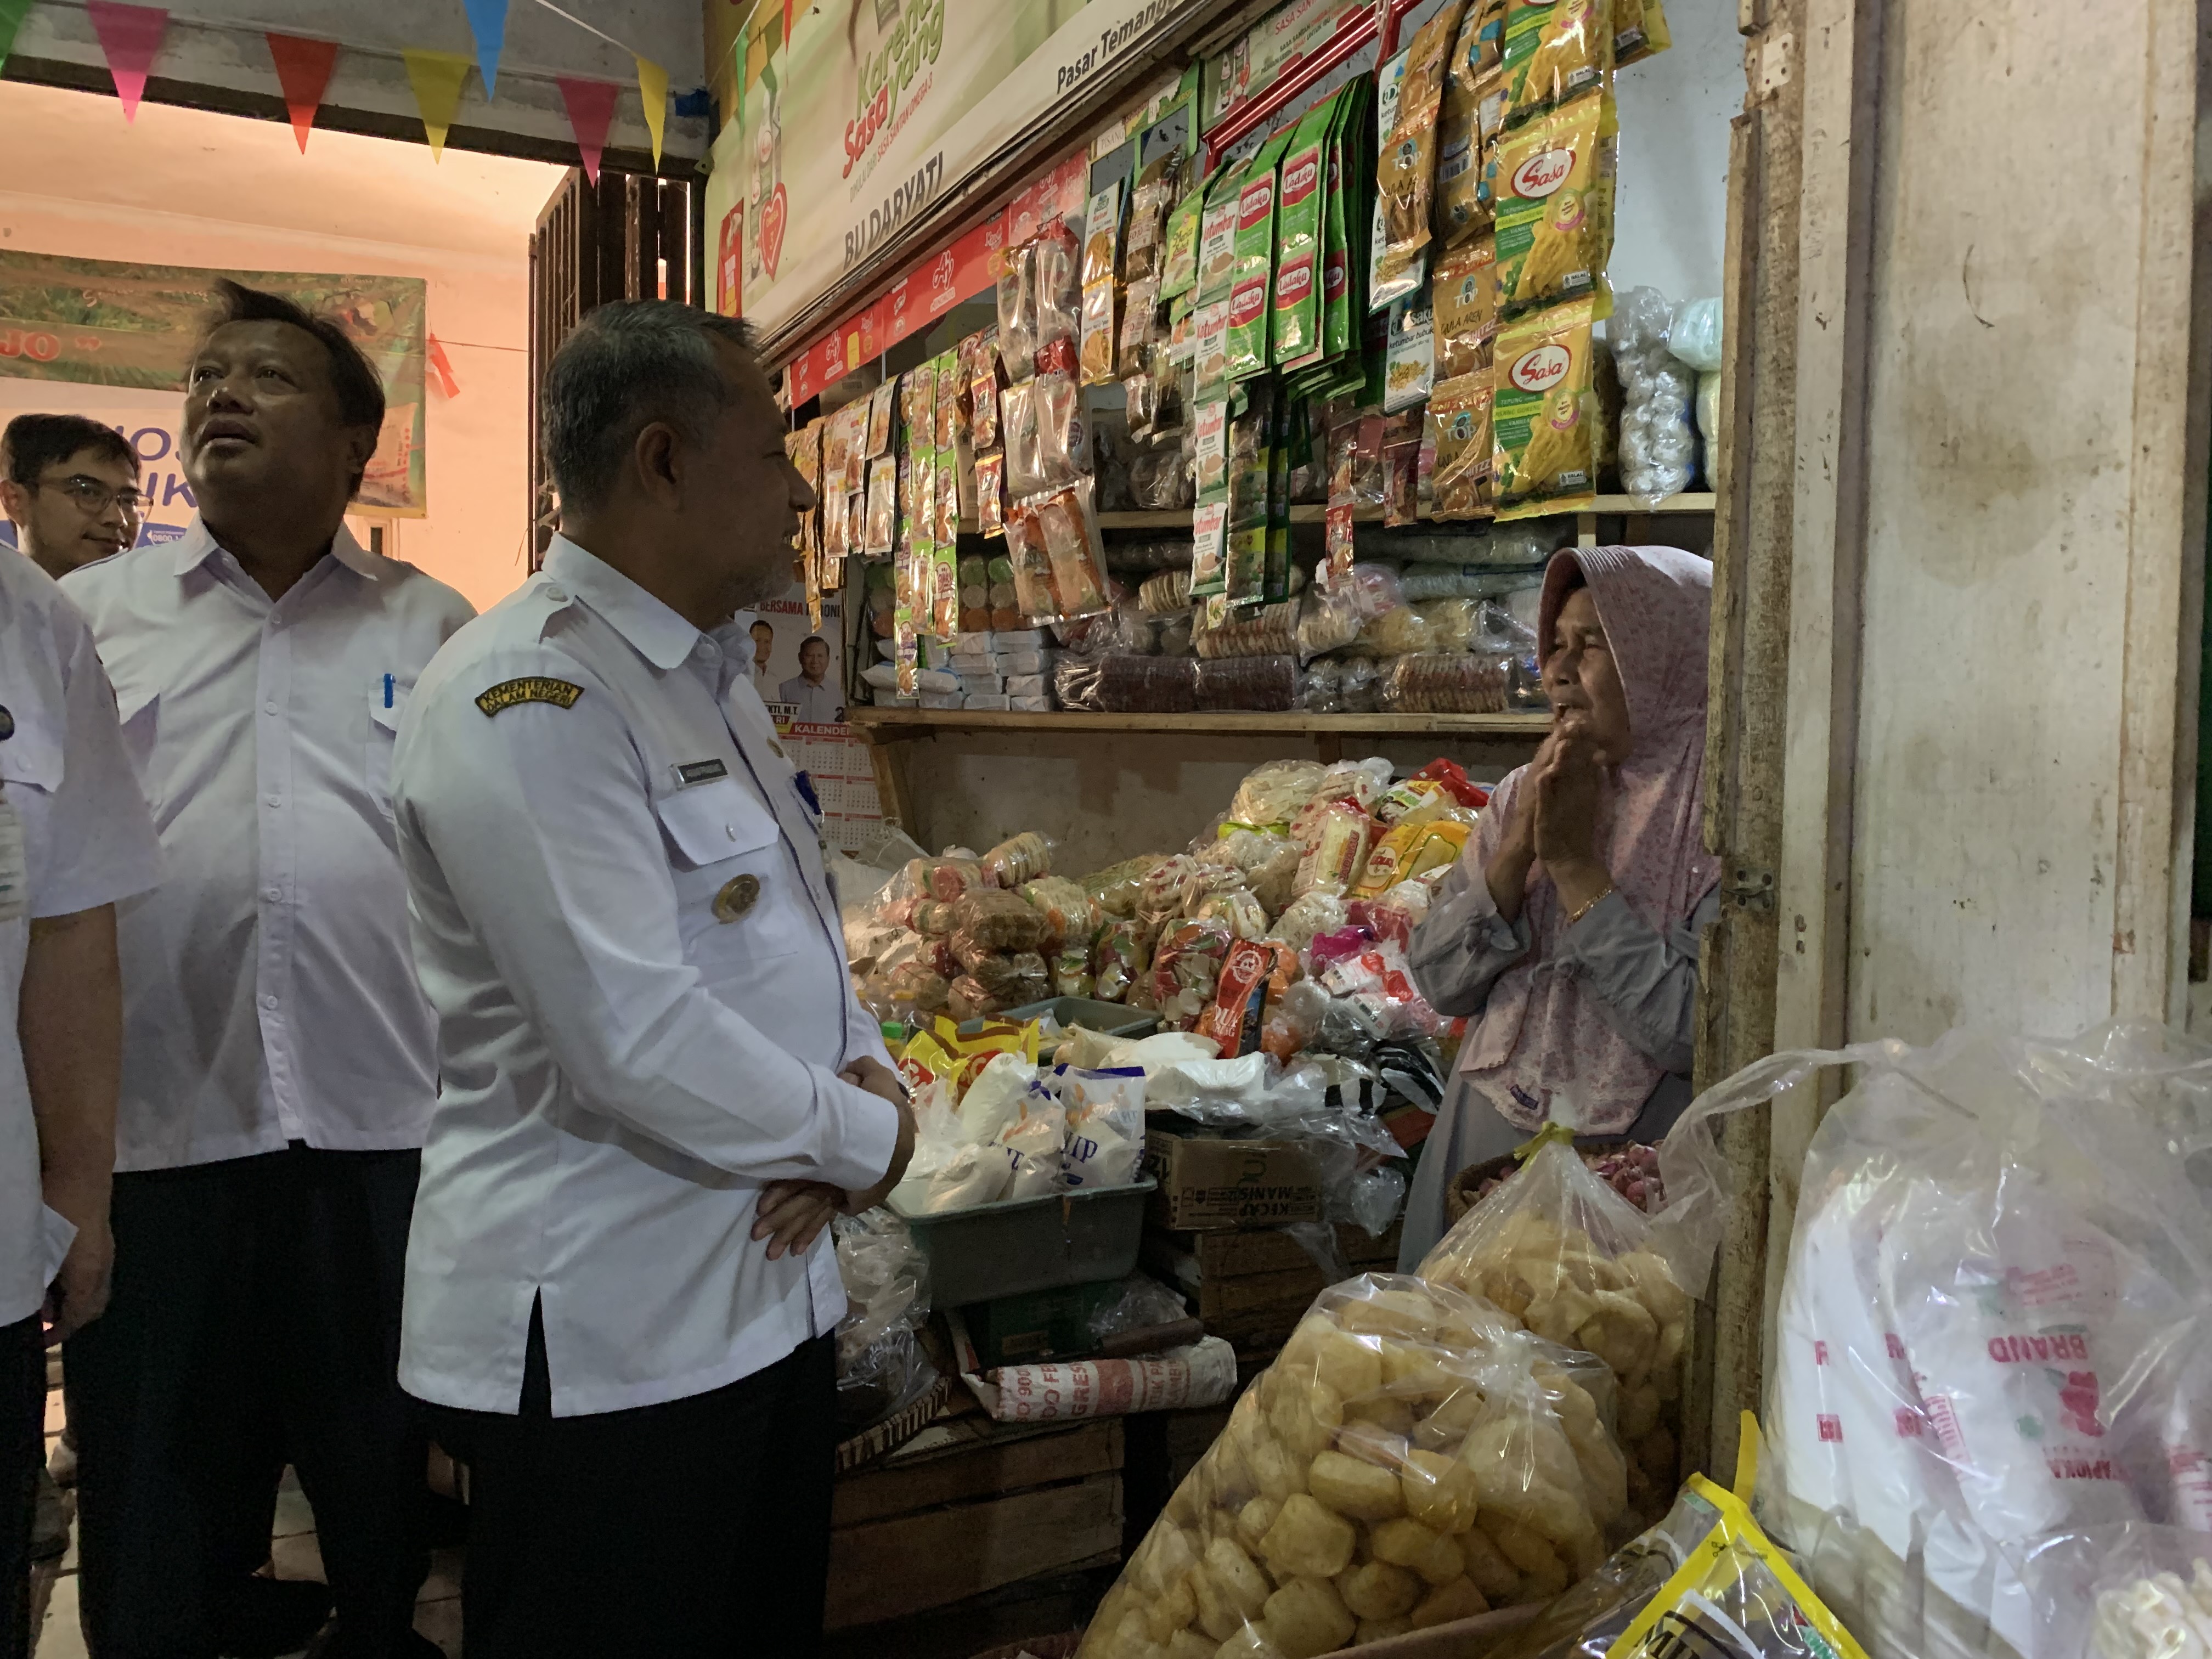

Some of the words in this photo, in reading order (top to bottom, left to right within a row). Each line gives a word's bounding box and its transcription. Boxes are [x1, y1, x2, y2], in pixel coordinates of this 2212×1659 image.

[1274, 12, 1295, 36] SASA
[1057, 45, 1098, 95] Pasar
[1285, 165, 1313, 190] Ladaku
[1521, 158, 1566, 192] Sasa
[843, 218, 865, 271] BU
[867, 150, 943, 248] DARYATI
[1241, 190, 1269, 215] Ladaku
[1278, 267, 1308, 292] Ladaku
[1231, 288, 1262, 312] Ladaku
[1453, 287, 1479, 309] TOP
[1462, 309, 1483, 326] AREN
[1389, 333, 1415, 349] ketumbar
[1520, 353, 1563, 385] Sasa
[1500, 396, 1522, 405] TEPUNG
[1444, 424, 1477, 442] TOP
[760, 600, 804, 616] BERSAMA
